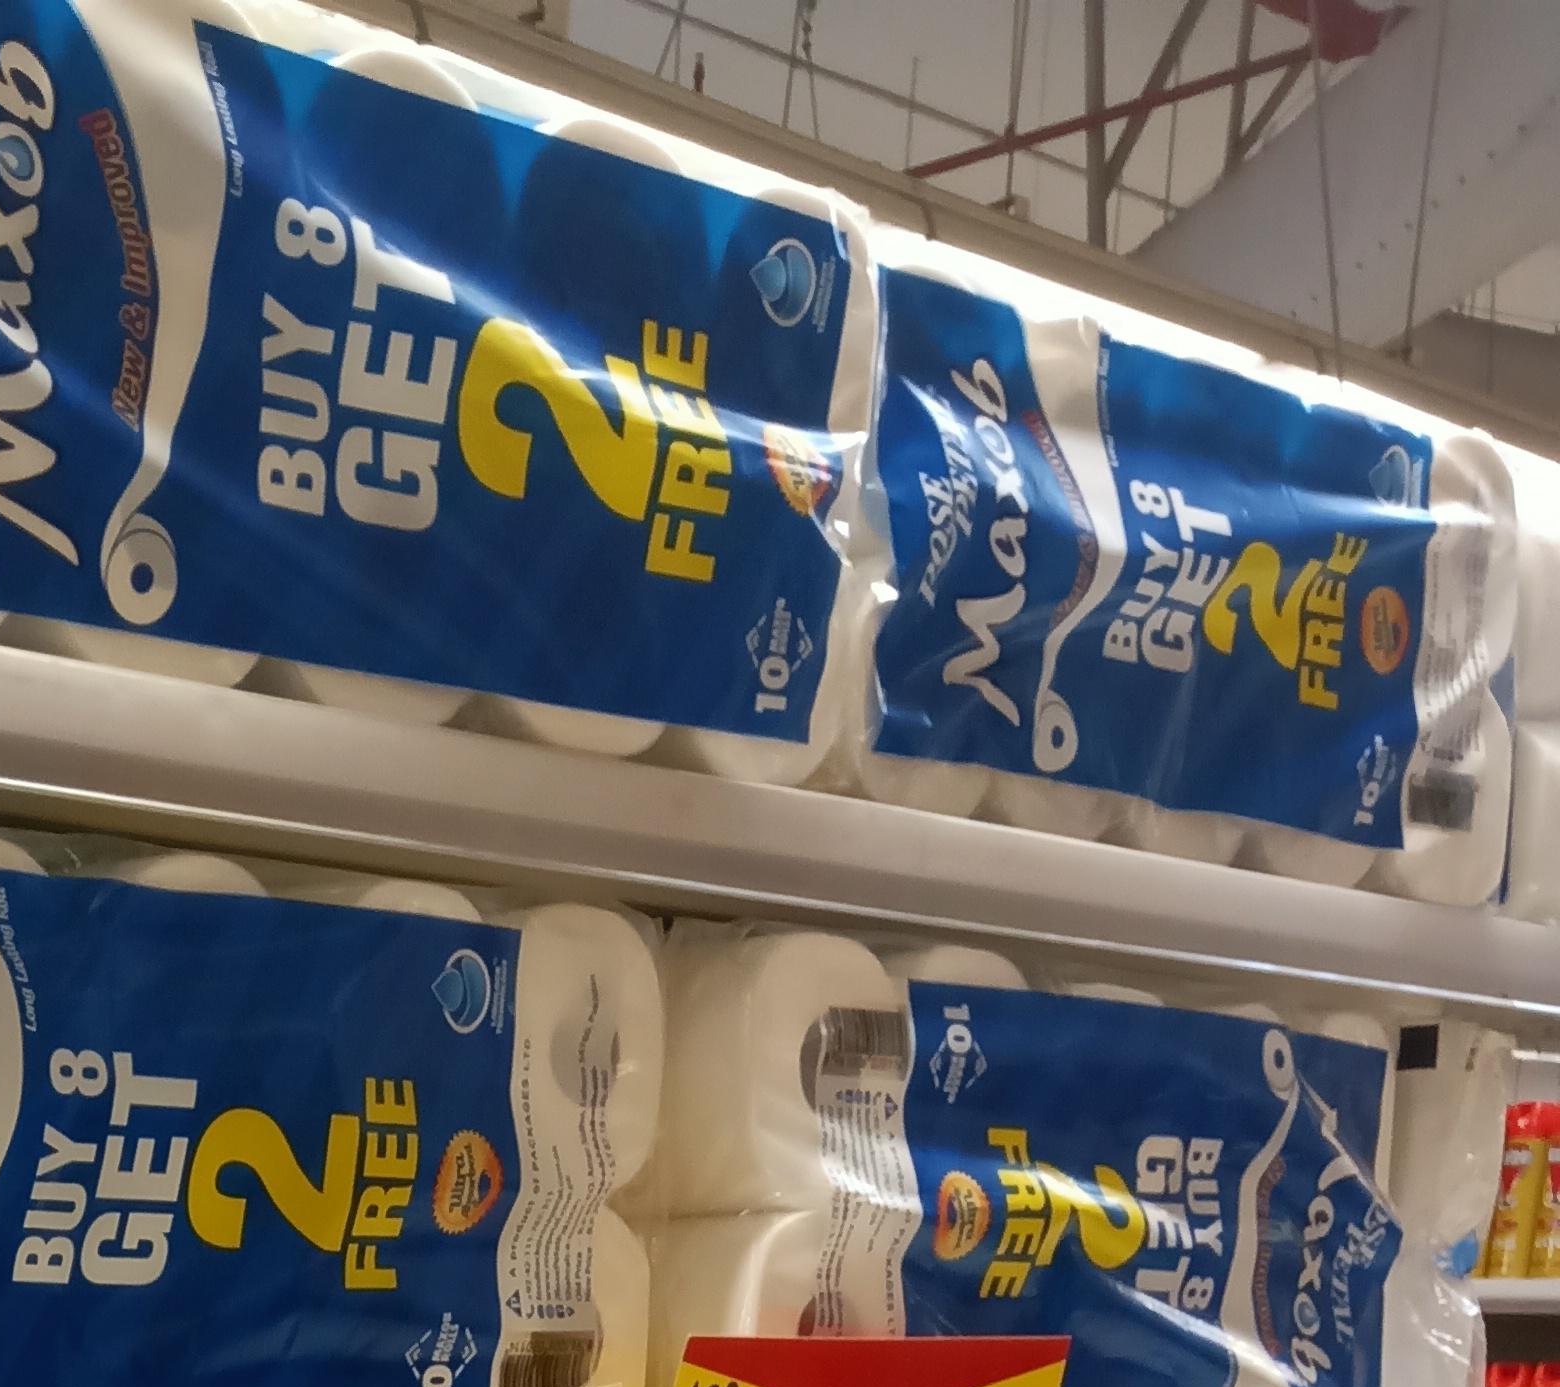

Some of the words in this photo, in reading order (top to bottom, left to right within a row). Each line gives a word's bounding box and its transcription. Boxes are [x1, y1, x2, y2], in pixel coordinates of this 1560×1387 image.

[78, 108, 153, 299] Improved
[275, 198, 348, 266] 8
[258, 293, 335, 516] BUY
[336, 215, 459, 532] GET
[458, 317, 659, 520] 2
[644, 319, 732, 583] FREE
[1103, 531, 1166, 664] BUY
[1142, 486, 1232, 673] GET
[1203, 541, 1321, 671] 2
[1298, 533, 1368, 710] FREE
[0, 924, 29, 983] Lasting
[24, 987, 38, 1032] Long
[49, 1048, 108, 1097] 8
[12, 1123, 98, 1285] BUY
[81, 1051, 197, 1286] GET
[188, 1107, 361, 1252] 2
[345, 1077, 419, 1289] FREE
[979, 1128, 1043, 1299] FREE
[1135, 1135, 1194, 1308] GET
[1187, 1137, 1224, 1257] BUY
